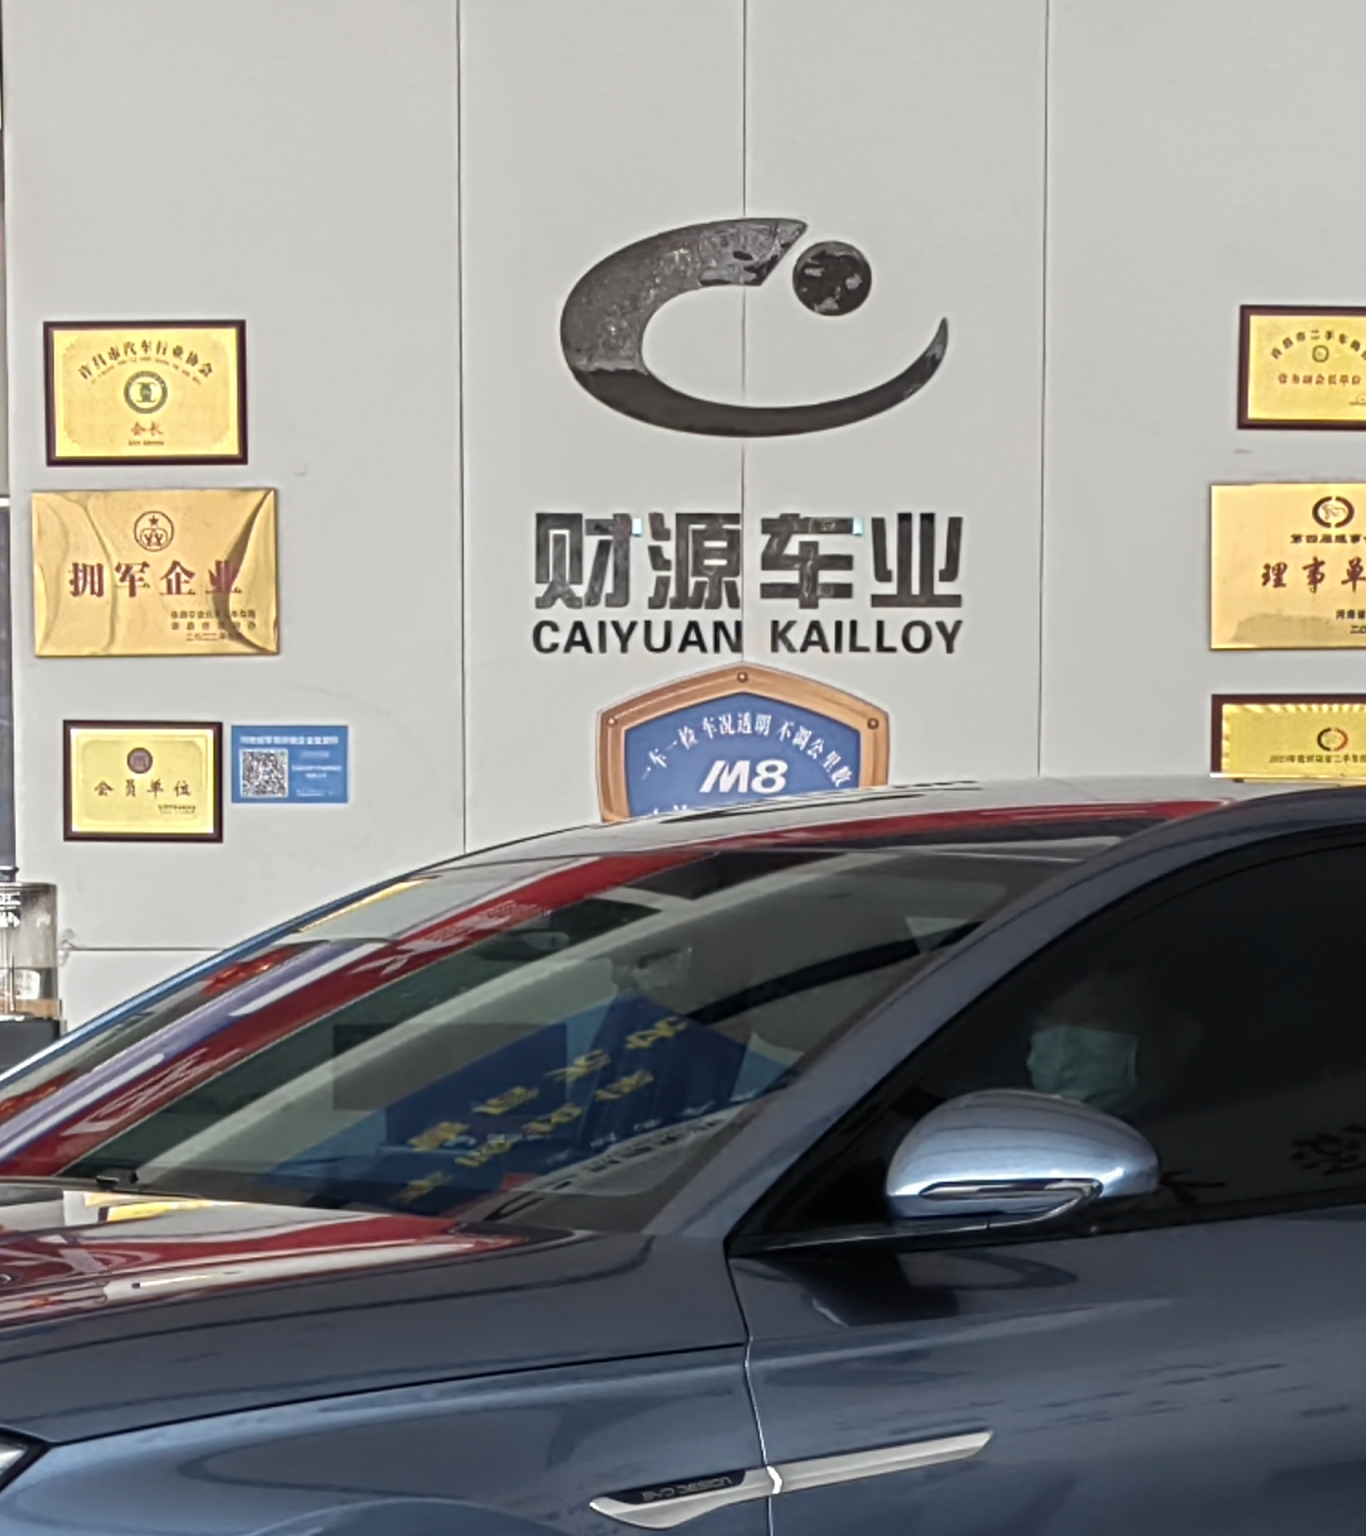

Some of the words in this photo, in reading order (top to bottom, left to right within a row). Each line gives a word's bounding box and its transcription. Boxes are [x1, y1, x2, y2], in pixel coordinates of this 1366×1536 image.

[535, 512, 963, 609] 财源车业
[68, 559, 243, 598] 拥军企业
[533, 619, 742, 654] CAIYUAN
[770, 619, 963, 654] KAILLOY
[94, 778, 192, 799] 会员单位
[699, 759, 788, 793] M8
